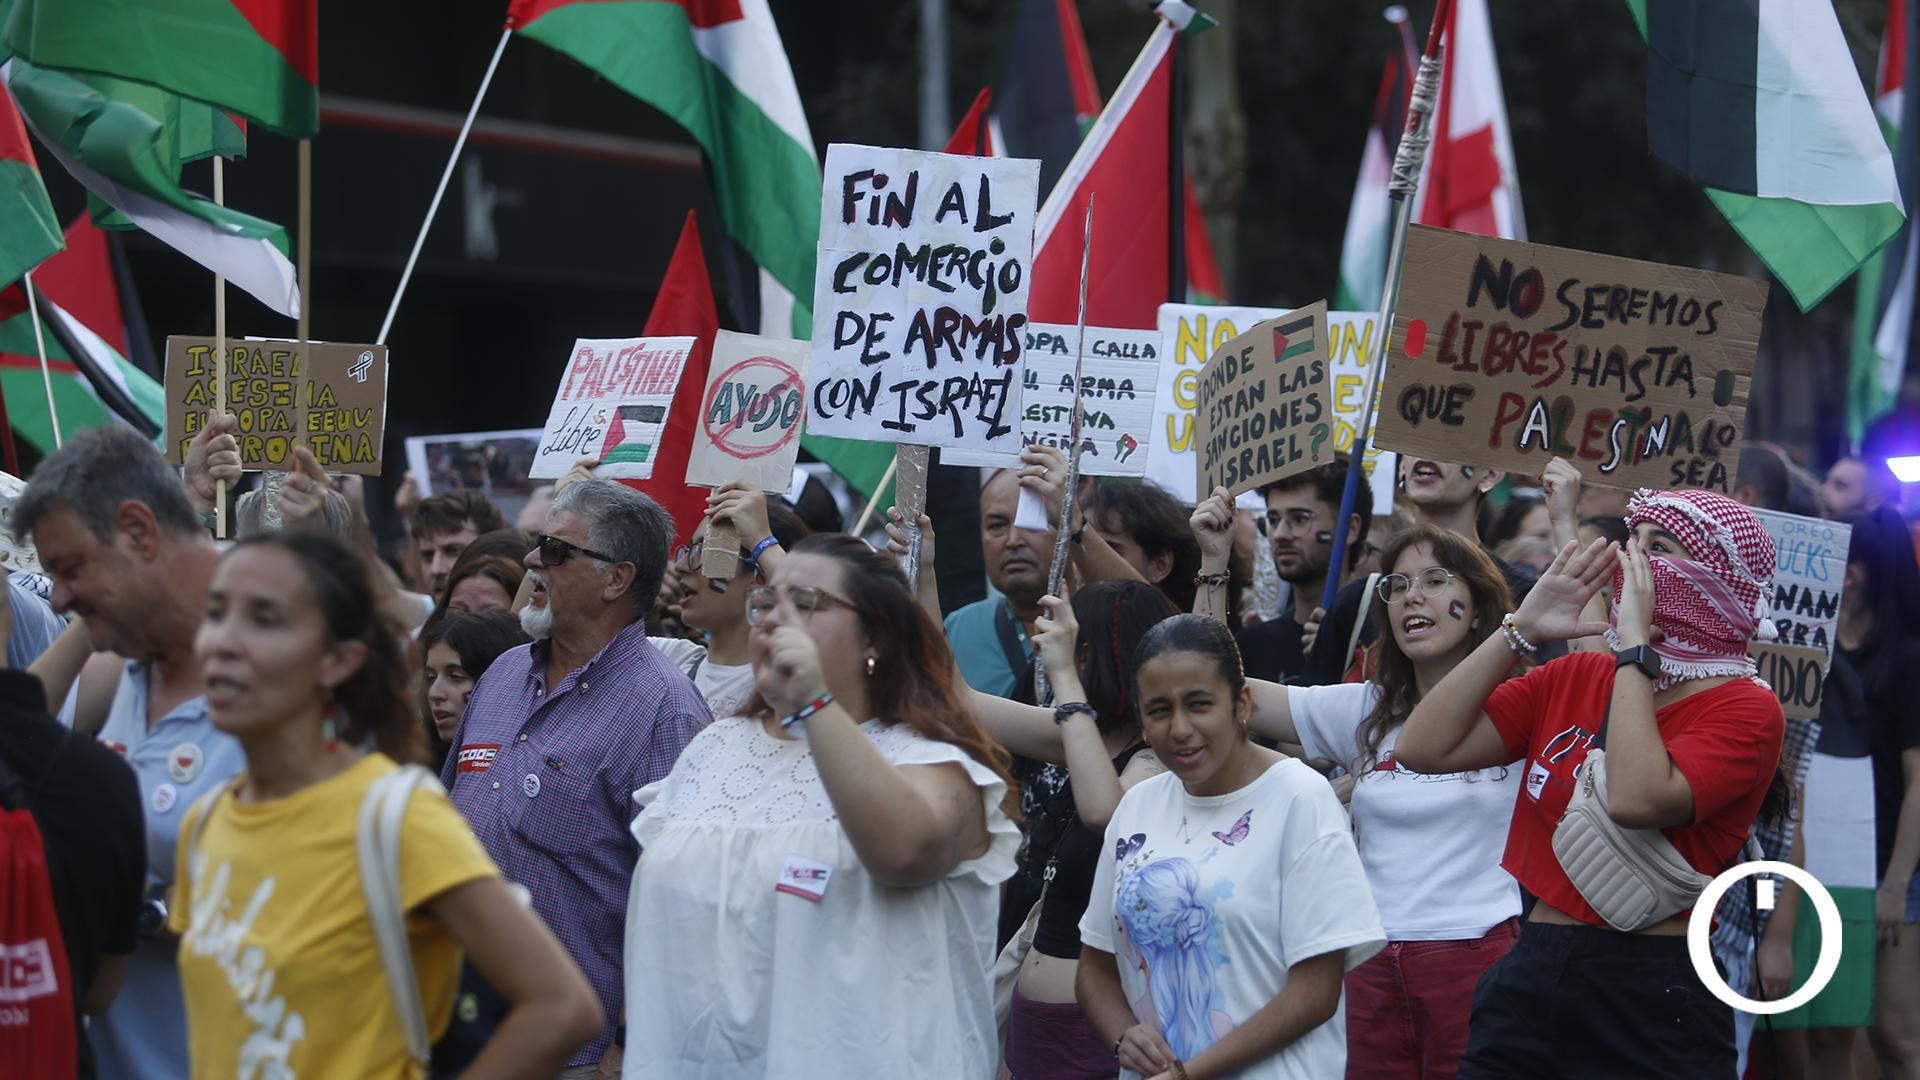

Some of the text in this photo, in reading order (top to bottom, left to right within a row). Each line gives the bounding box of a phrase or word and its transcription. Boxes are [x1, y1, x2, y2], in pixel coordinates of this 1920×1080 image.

[935, 173, 1015, 232] AL
[1466, 253, 1724, 336] NO SEREMOS
[834, 306, 1027, 369] DE ARMAS
[1092, 340, 1157, 359] CALLA
[1436, 311, 1696, 402] LIBRES HASTA
[560, 343, 683, 401] PALESTINA
[1058, 373, 1136, 400] ARMA
[1279, 360, 1324, 395] LAS
[185, 408, 290, 434] EOPA
[542, 403, 601, 456] Libre
[708, 381, 801, 433] AYUSO
[814, 368, 1013, 440] CON ISRAEL
[1022, 403, 1115, 430] ESTINA
[1399, 383, 1475, 428] QUE
[1699, 418, 1736, 456] LO
[1204, 392, 1322, 472] SANCIONES
[1669, 458, 1728, 491] SEA
[1776, 537, 1833, 582] UCKS
[1770, 583, 1839, 619] NAN
[1775, 618, 1829, 650] RRA
